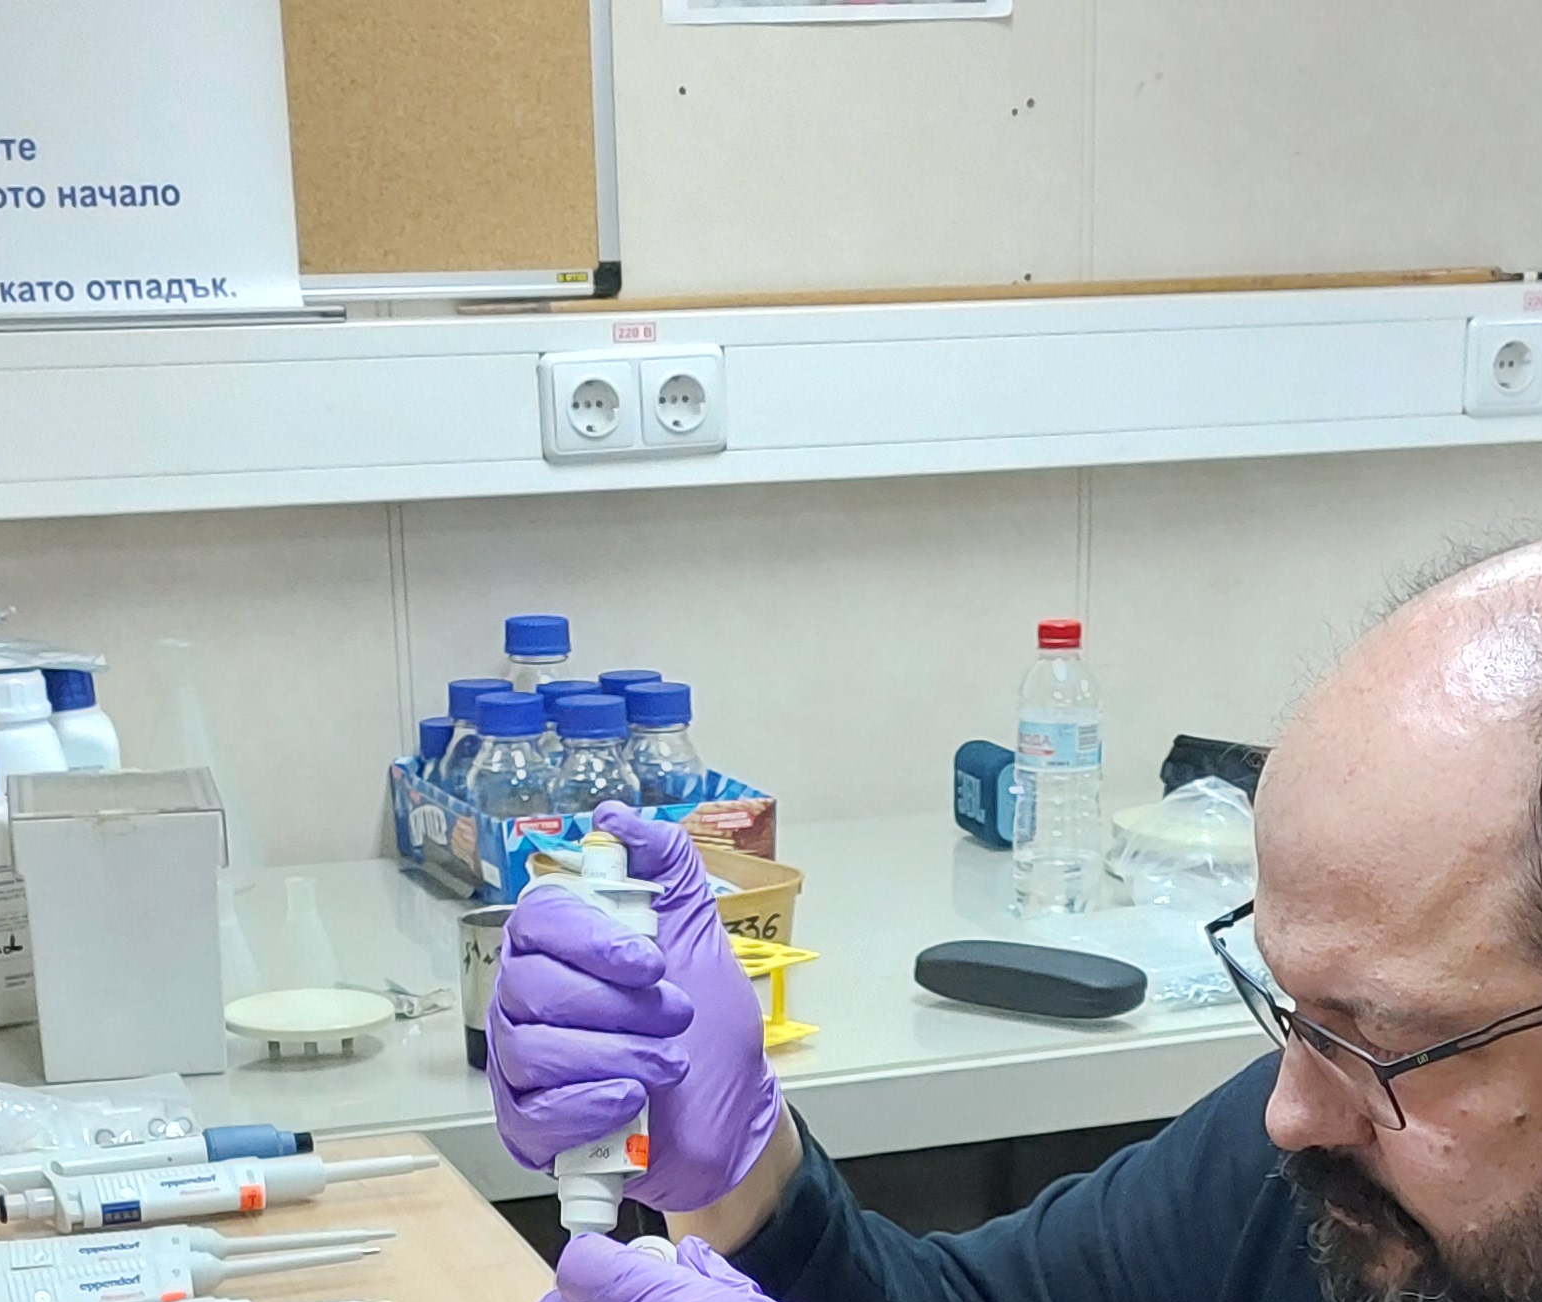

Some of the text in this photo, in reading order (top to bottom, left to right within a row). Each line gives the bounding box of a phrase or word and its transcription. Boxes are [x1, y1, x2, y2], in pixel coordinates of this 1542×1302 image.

[57, 181, 182, 209] начало
[0, 279, 75, 305] като
[86, 273, 238, 305] отпадък.
[618, 327, 640, 339] 220
[958, 770, 987, 825] JBL
[160, 1174, 217, 1189] eppendorf
[78, 1241, 141, 1256] eppendorf
[79, 1274, 142, 1293] eppendorf
